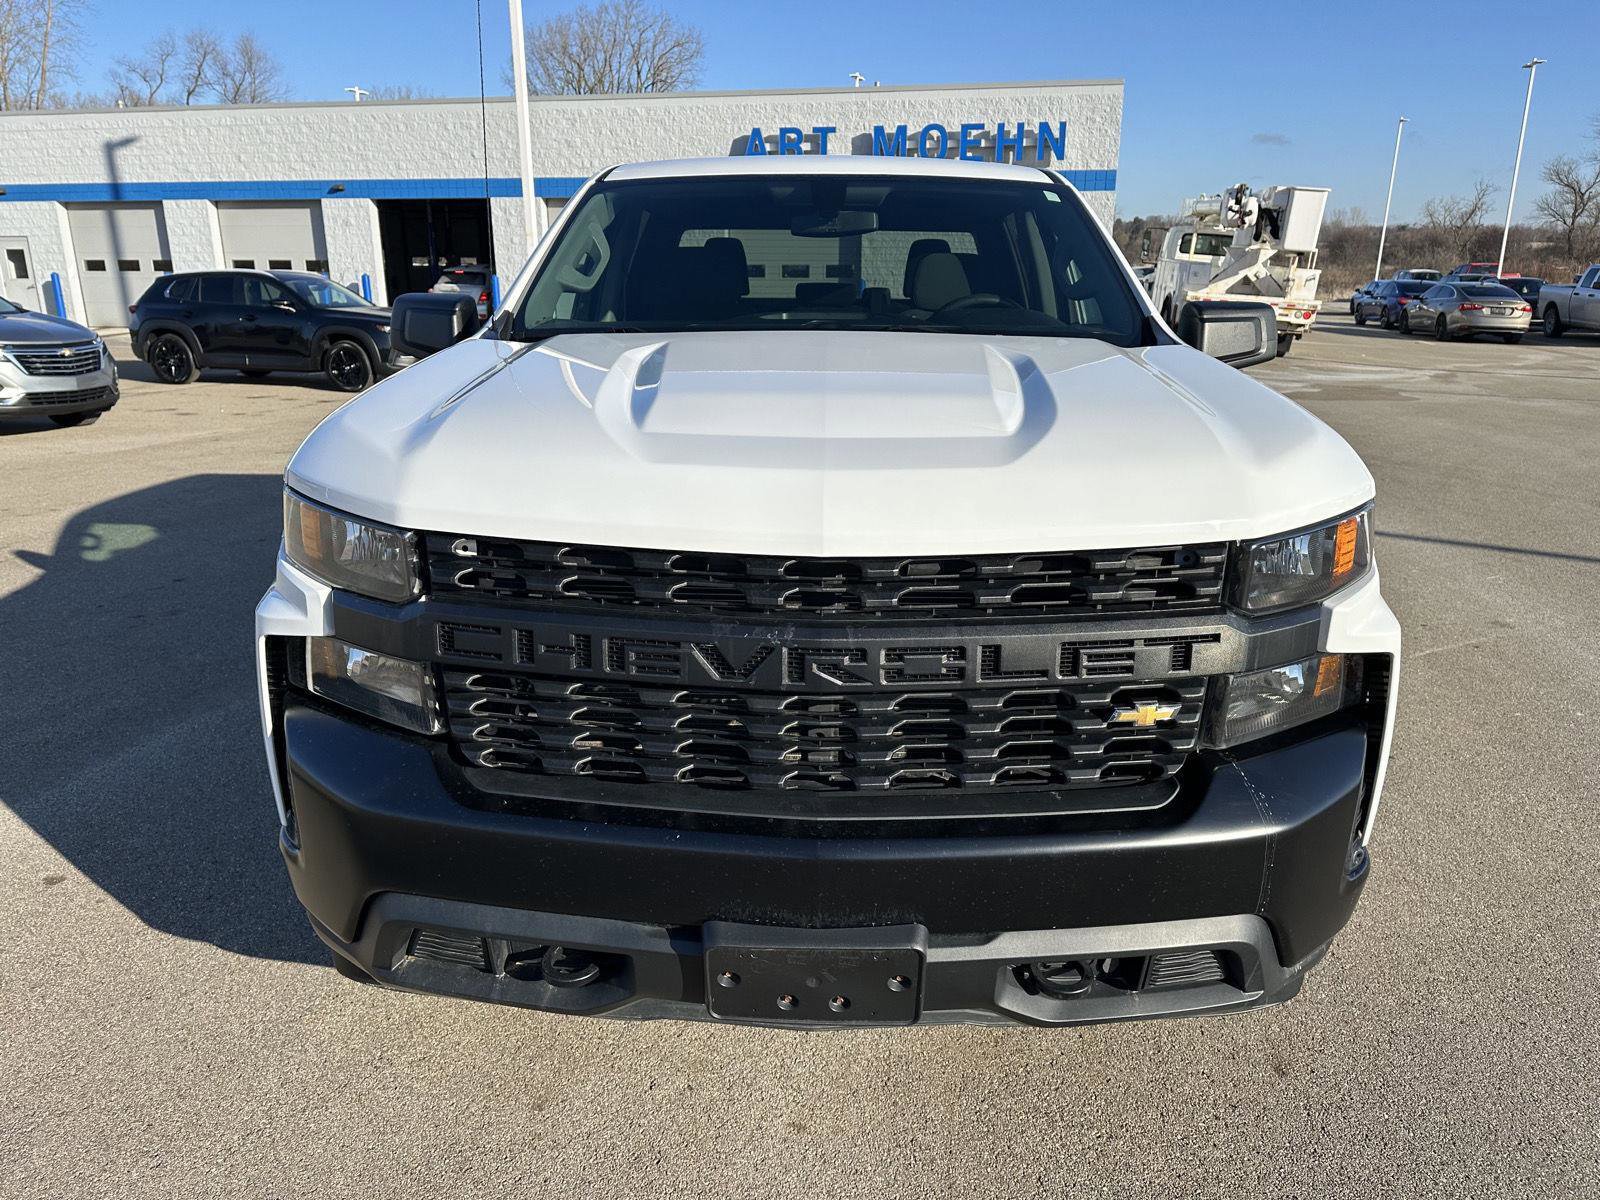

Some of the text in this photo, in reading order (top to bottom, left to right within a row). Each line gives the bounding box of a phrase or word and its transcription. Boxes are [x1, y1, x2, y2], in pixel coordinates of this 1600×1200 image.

[745, 121, 1067, 162] ART MOEHN
[435, 621, 1221, 686] CHEVROLET
